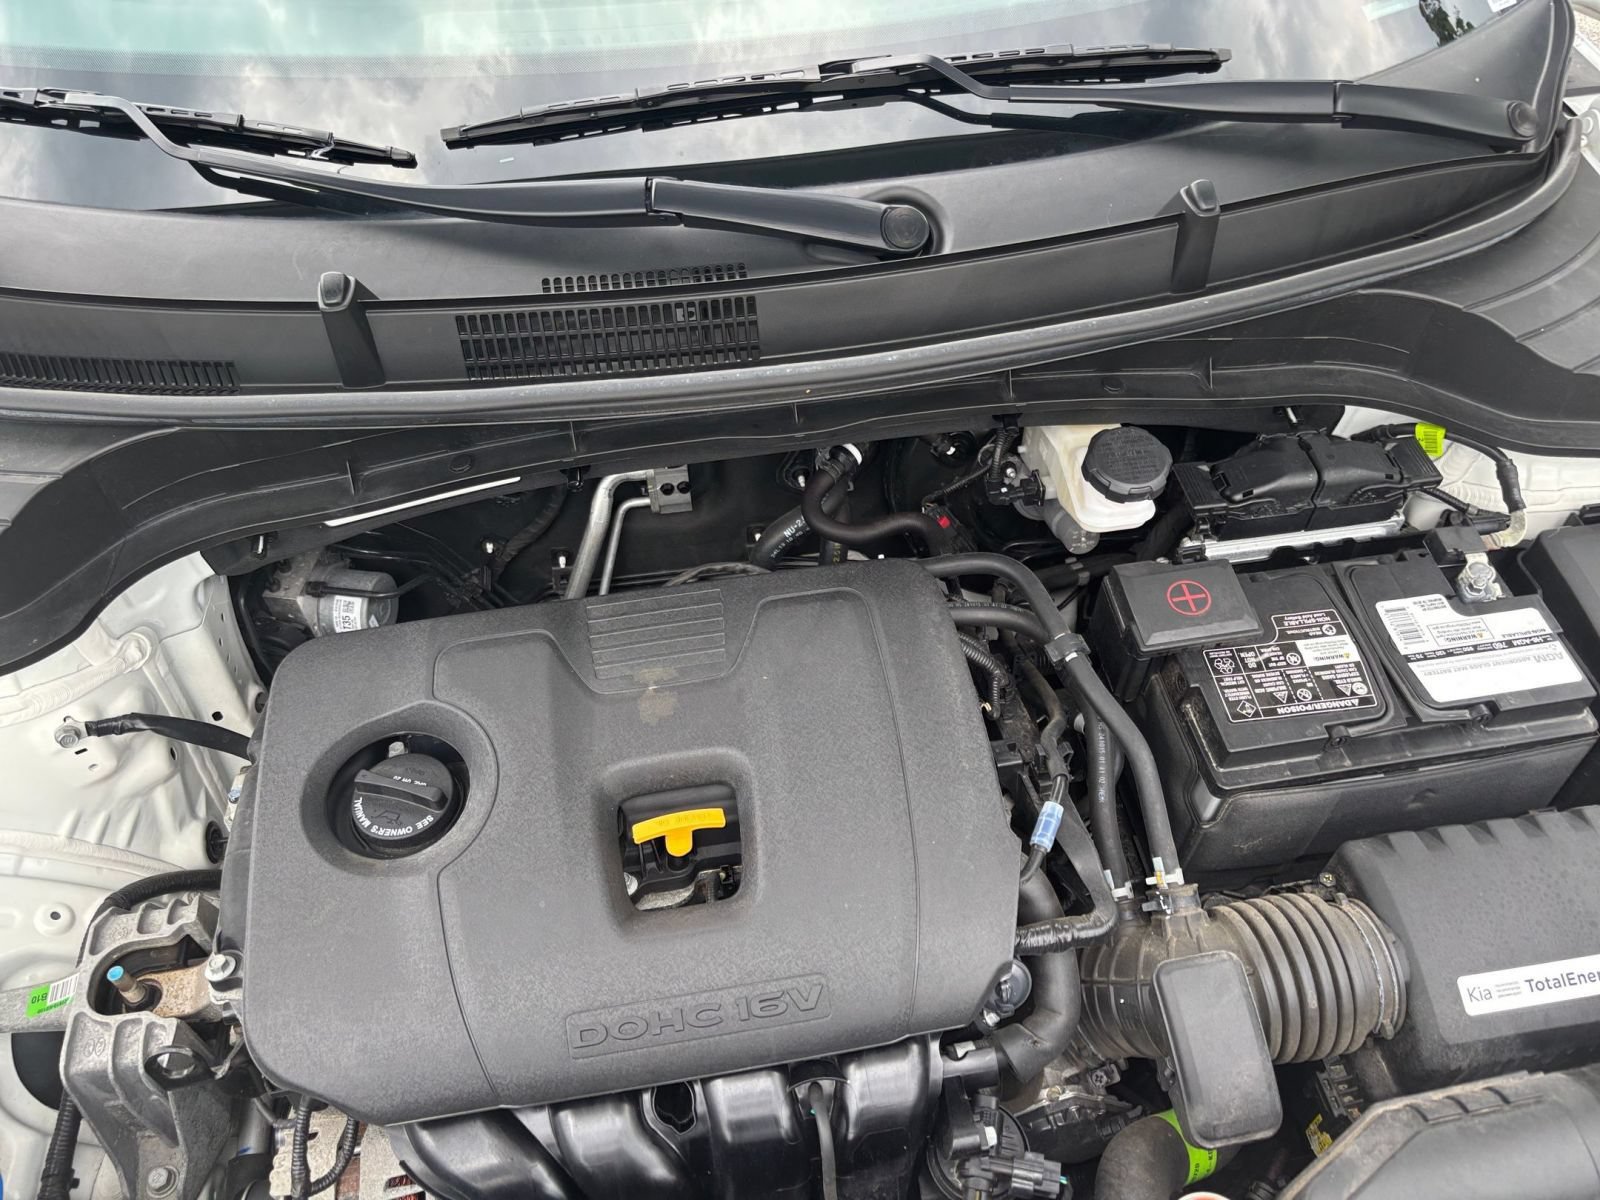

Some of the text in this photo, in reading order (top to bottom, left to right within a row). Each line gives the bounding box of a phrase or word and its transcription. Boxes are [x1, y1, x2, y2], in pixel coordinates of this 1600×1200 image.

[1277, 700, 1353, 714] DANGER/POISON
[354, 797, 434, 837] SEE OWNER'S MANUAL
[1466, 986, 1493, 1003] Kia
[573, 984, 825, 1050] DOHC 16V
